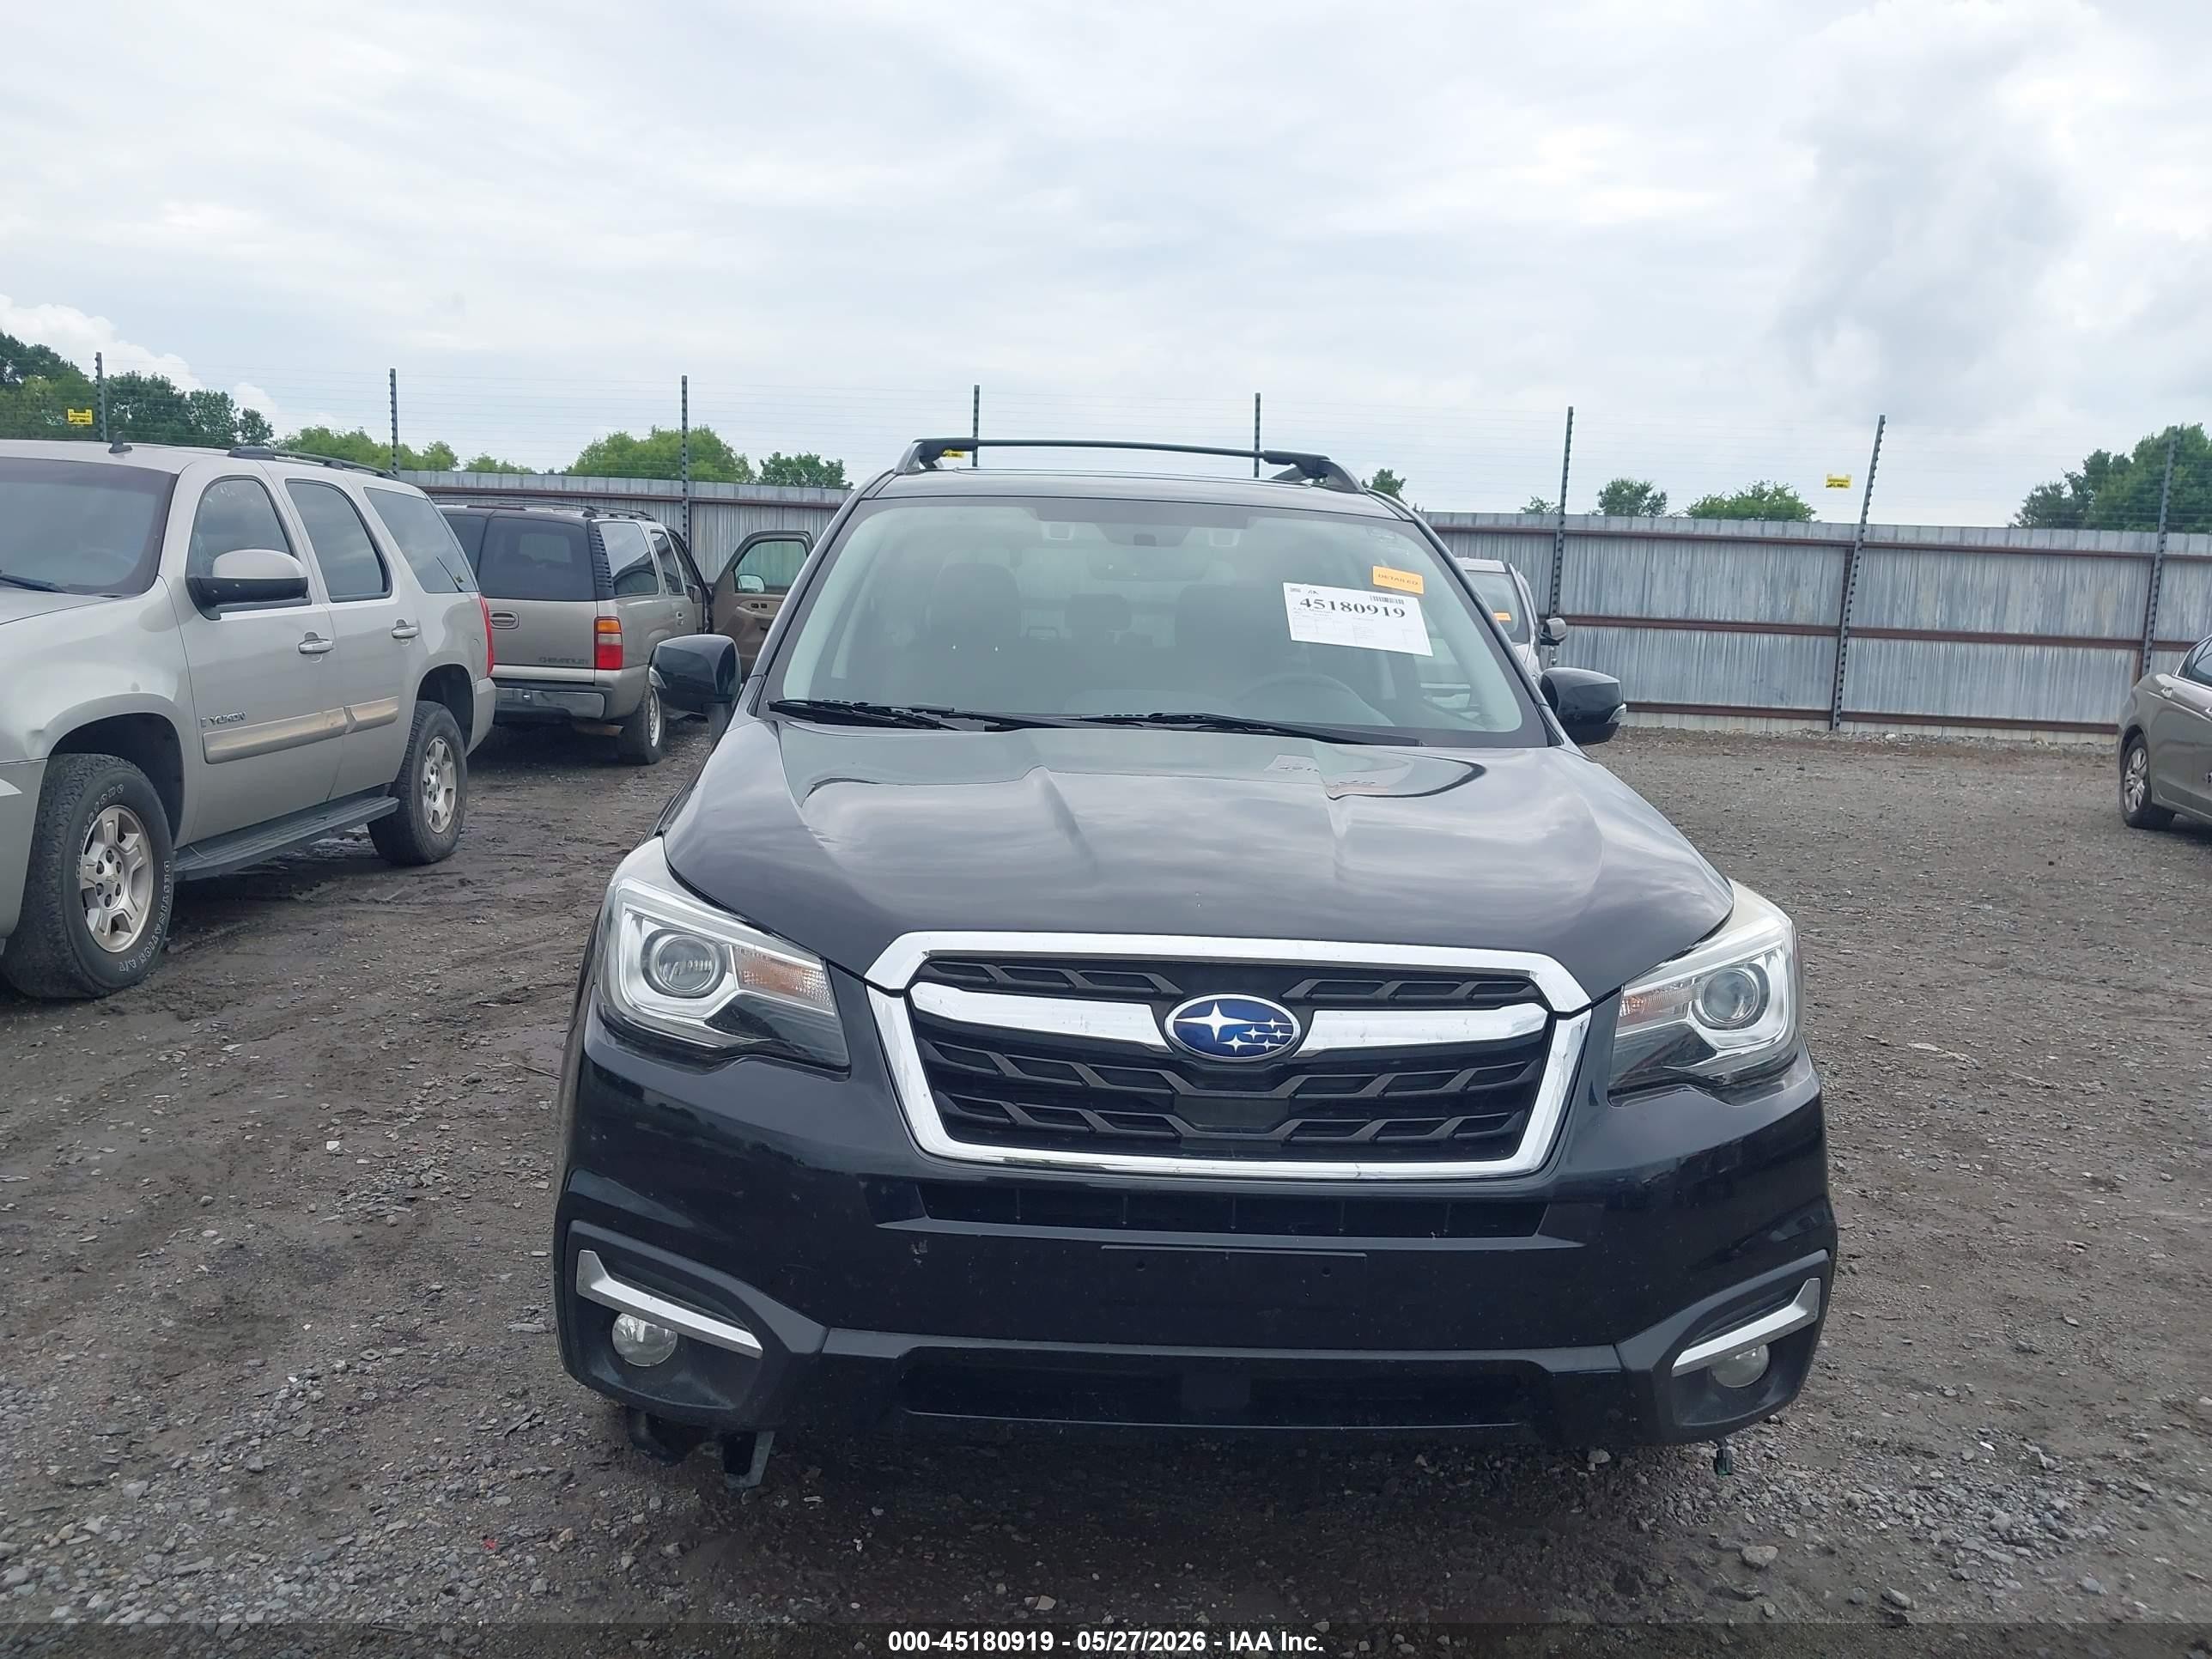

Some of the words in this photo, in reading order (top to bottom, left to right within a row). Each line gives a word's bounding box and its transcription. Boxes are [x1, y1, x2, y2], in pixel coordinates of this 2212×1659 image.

[1377, 573, 1419, 586] DETAILED
[1299, 598, 1406, 618] 45180919
[138, 860, 173, 964] DESTINATION
